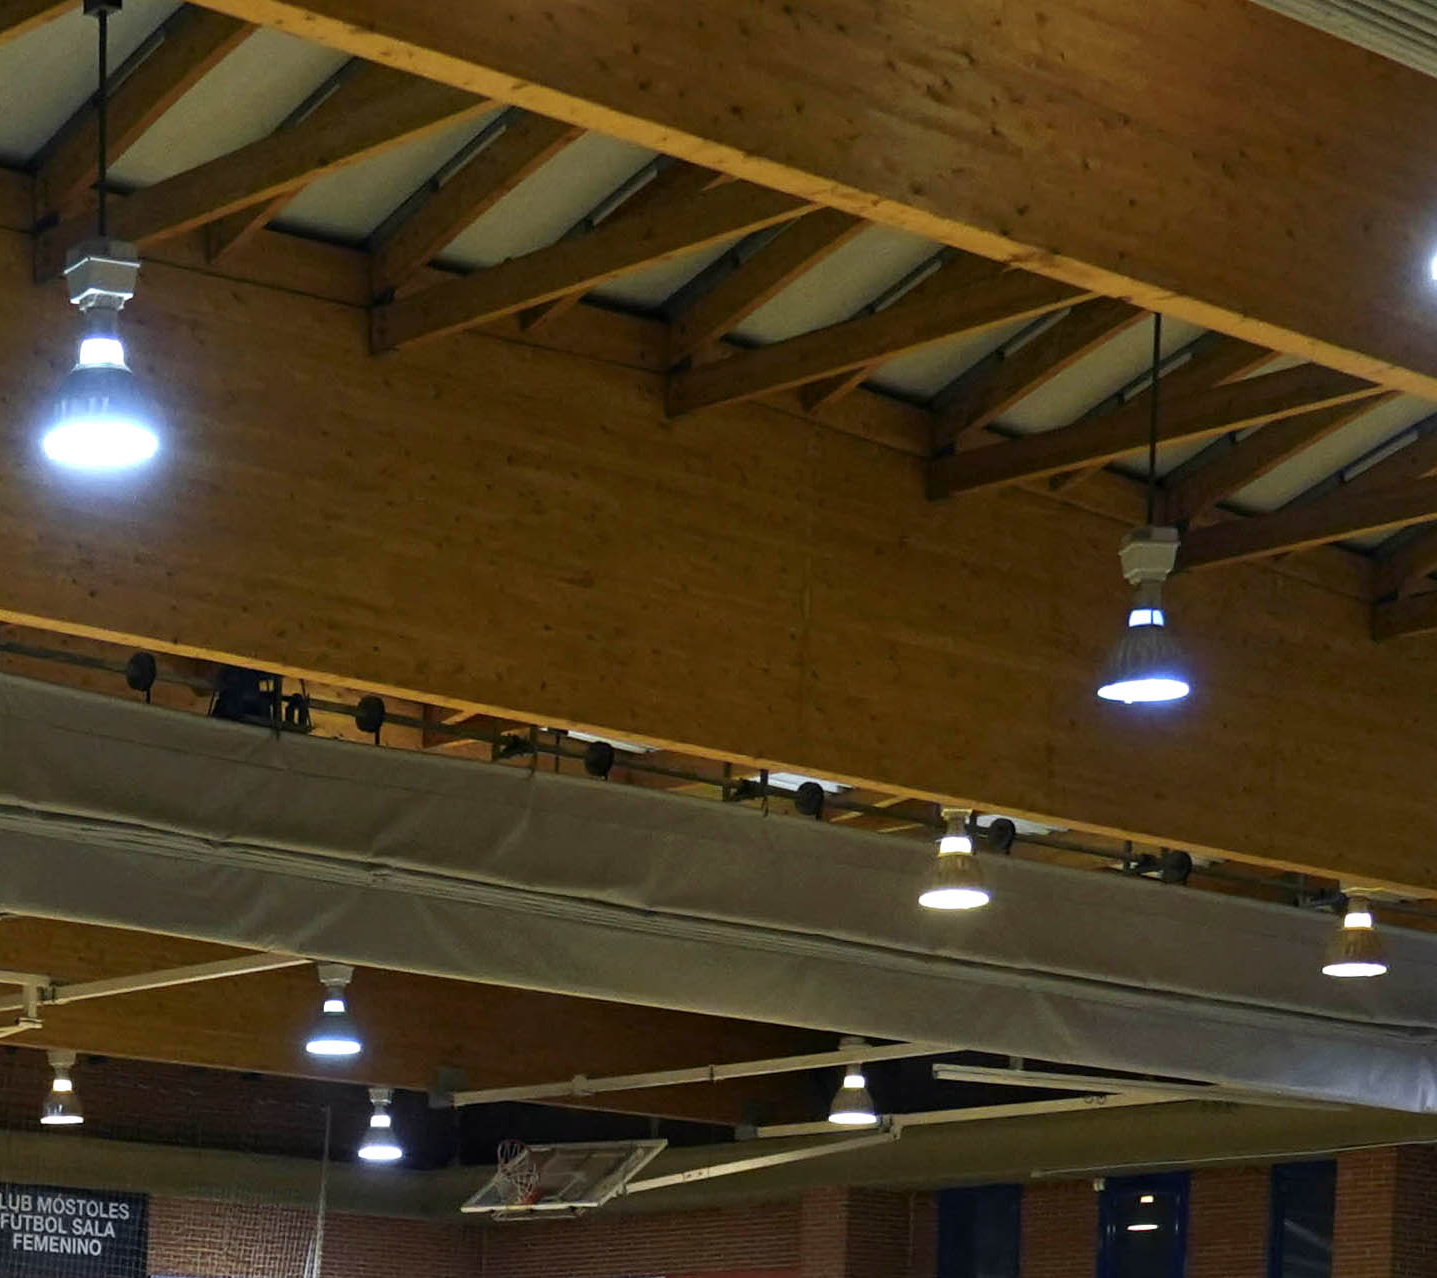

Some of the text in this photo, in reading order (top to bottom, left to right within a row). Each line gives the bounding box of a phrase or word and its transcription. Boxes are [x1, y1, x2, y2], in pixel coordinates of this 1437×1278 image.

[36, 1194, 130, 1220] MÓSTOLES
[72, 1219, 115, 1238] SALA
[13, 1233, 102, 1256] FEMENINO
